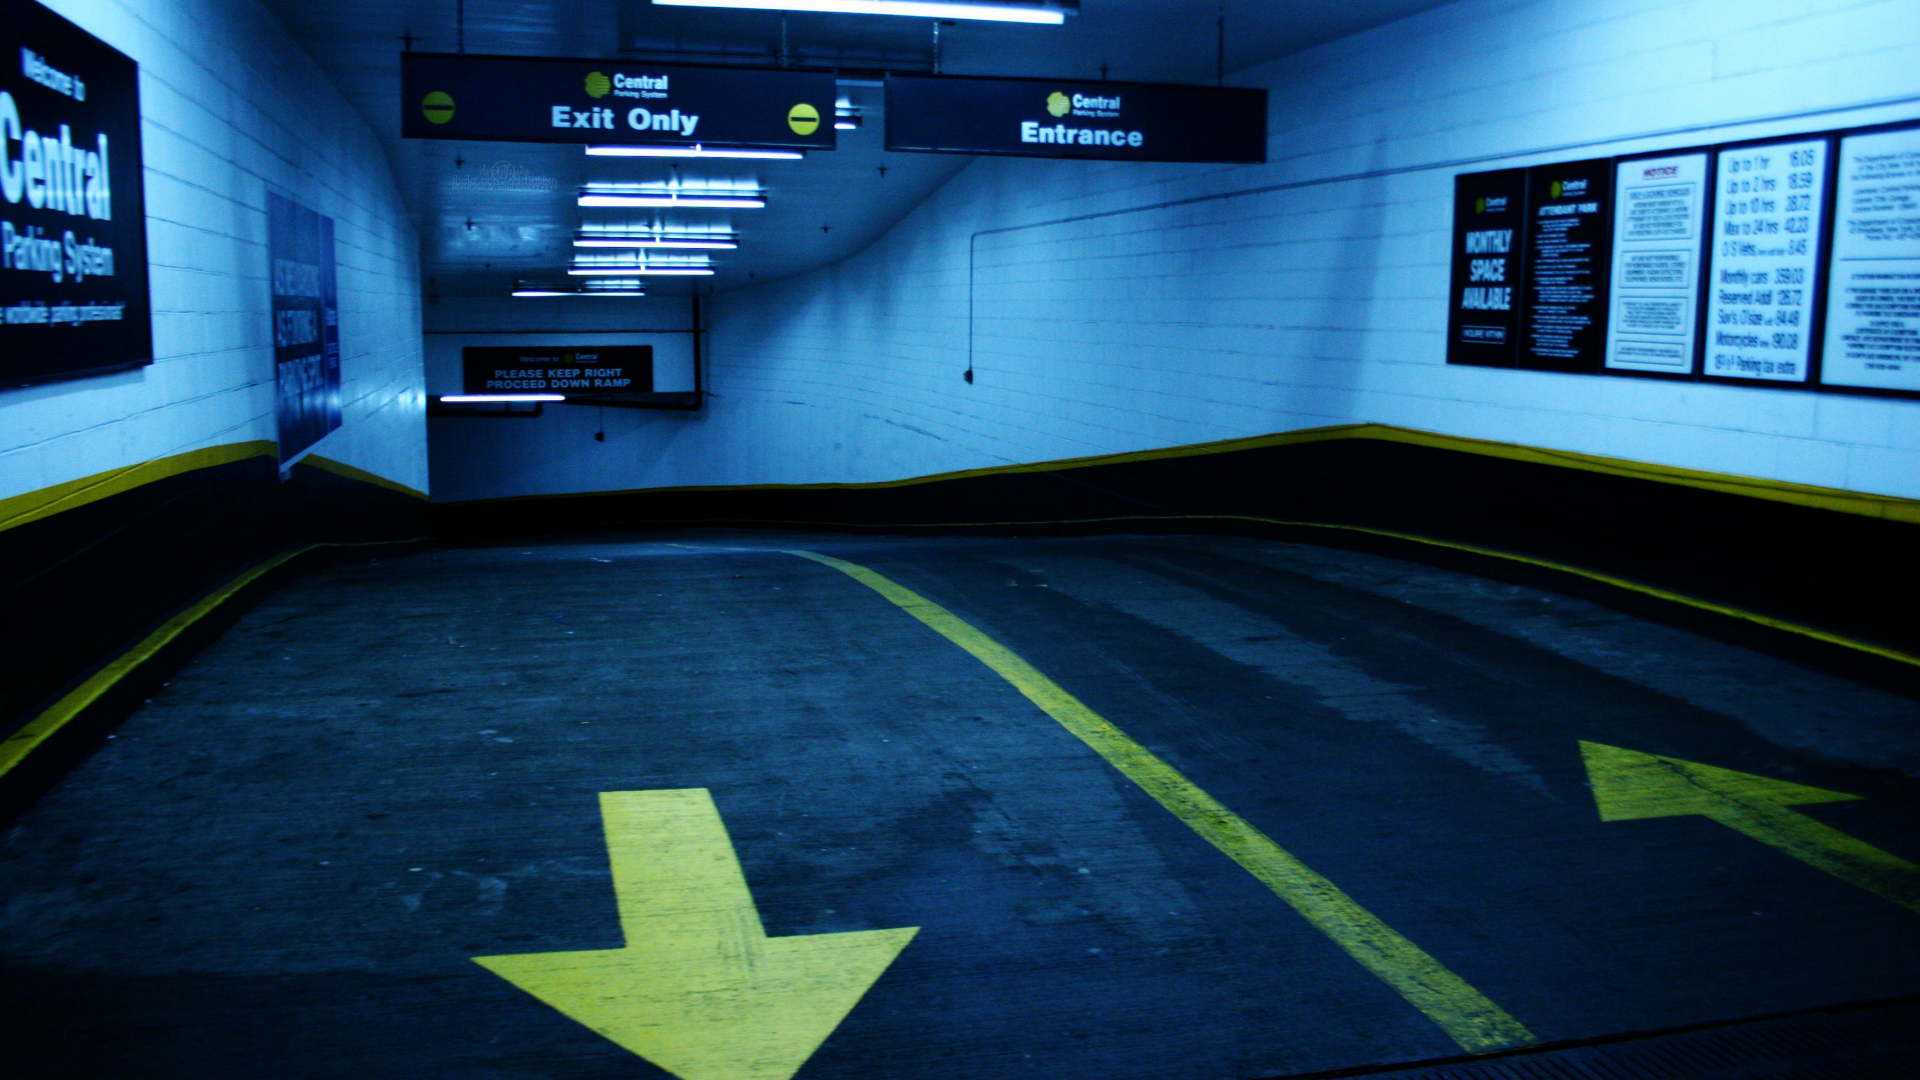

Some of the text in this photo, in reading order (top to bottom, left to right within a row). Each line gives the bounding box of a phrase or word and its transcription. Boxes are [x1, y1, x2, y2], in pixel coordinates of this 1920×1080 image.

[21, 46, 86, 101] Welcome to
[613, 73, 668, 90] Central
[613, 90, 640, 98] Parking
[1072, 93, 1120, 109] Central
[551, 105, 699, 136] Exit Only
[1072, 109, 1120, 118] Parking System
[1021, 121, 1143, 147] Entrance
[0, 91, 112, 221] Central
[1728, 157, 1740, 174] Up
[1742, 157, 1751, 172] to
[1760, 155, 1770, 170] hr
[1643, 165, 1679, 177] NOTICE
[1562, 179, 1587, 191] Central
[1726, 178, 1738, 196] Up
[1741, 179, 1750, 193] to
[1753, 176, 1759, 192] 2
[1761, 176, 1776, 192] hrs
[1485, 197, 1507, 207] Central
[1538, 202, 1598, 216] ATTENDANT PARK
[1725, 200, 1737, 218] Up
[1738, 200, 1748, 214] to
[1750, 198, 1760, 214] 10
[1761, 197, 1775, 213] hrs
[1724, 220, 1740, 236] Max
[1742, 221, 1751, 235] to
[1752, 219, 1763, 235] 24
[1764, 219, 1779, 235] hrs
[1465, 229, 1513, 254] MONTHLY
[1, 221, 114, 283] Parking System
[1470, 259, 1506, 282] SPACE
[1720, 269, 1748, 287] Monthly
[1750, 271, 1768, 285] cars
[1461, 286, 1512, 310] AVAILABLE
[1719, 289, 1753, 305] Reserved
[1715, 330, 1758, 350] Motorcycles
[494, 368, 622, 378] PLEASE KEEP RIGHT
[1737, 355, 1761, 376] Parking
[1763, 359, 1774, 374] tax
[1776, 360, 1796, 375] extra
[486, 378, 631, 389] PROCEED DOWN RAMP
